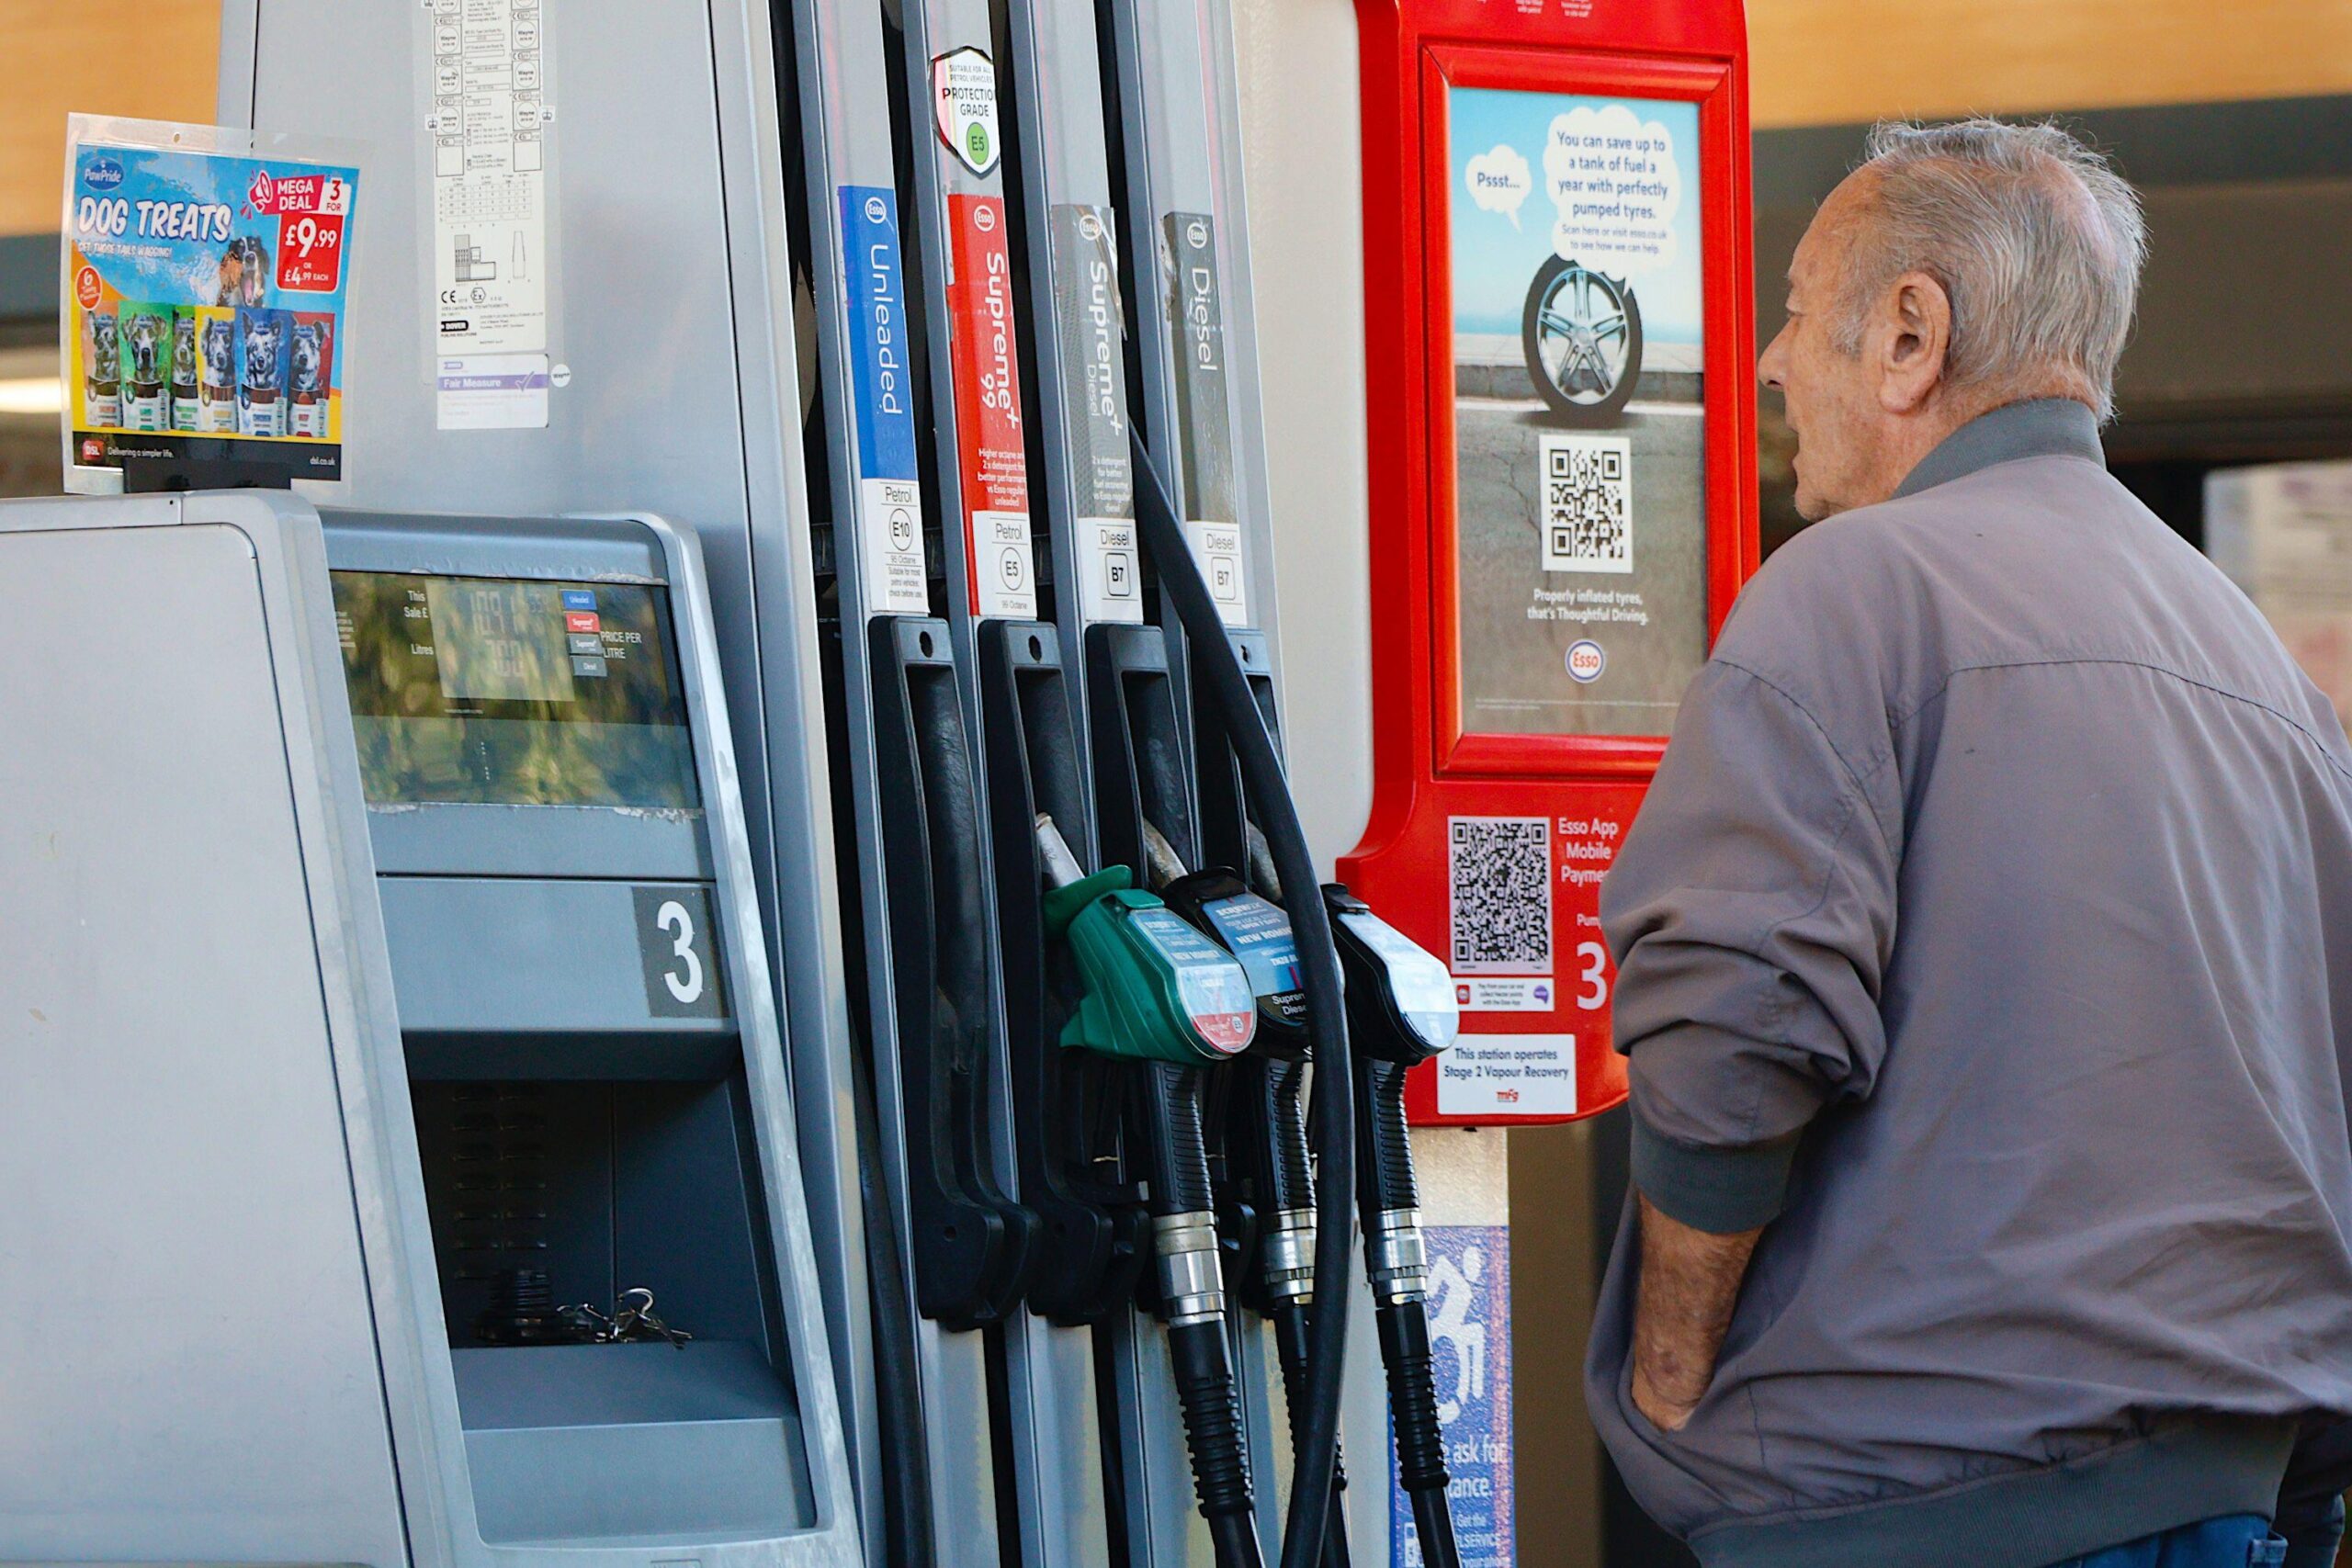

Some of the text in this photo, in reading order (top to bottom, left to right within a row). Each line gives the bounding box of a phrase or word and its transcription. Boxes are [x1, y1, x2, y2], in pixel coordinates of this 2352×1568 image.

[949, 64, 972, 73] SUITABLE
[950, 74, 993, 85] PETROL VEHICLES
[942, 87, 994, 101] PROTECTIO
[960, 104, 989, 117] GRADE
[971, 136, 985, 152] E5
[1557, 131, 1666, 154] You can save up to
[1568, 155, 1657, 174] a tank of fuel a
[84, 168, 121, 184] PawPride
[1477, 172, 1521, 189] Pssst...
[277, 179, 314, 195] MEGA
[329, 179, 342, 201] 3
[1558, 177, 1668, 201] year with perfectly
[278, 195, 312, 210] DEAL
[326, 202, 342, 211] FOR
[867, 203, 884, 216] Esso
[977, 212, 992, 224] Esso
[1573, 202, 1657, 222] pumped tyres.
[79, 197, 232, 243] DOG TREATS
[285, 218, 337, 258] £9.99
[1189, 228, 1205, 242] Esso
[1561, 223, 1668, 241] Scan here or visit esso.co.uk
[117, 245, 136, 256] TAILS
[1570, 240, 1578, 250] to
[1580, 243, 1594, 251] see
[1596, 241, 1612, 253] how
[1615, 244, 1625, 253] we
[1628, 244, 1642, 254] can
[84, 270, 93, 287] 6
[1192, 268, 1218, 371] Diesel
[870, 244, 903, 414] Unleaded
[985, 252, 1019, 429] Supreme+
[1089, 261, 1123, 436] Supreme+
[443, 378, 502, 389] Fair Measure
[980, 373, 996, 409] 99
[1086, 365, 1101, 417] Diesel
[85, 446, 175, 458] DSL Delivering simpler life.
[978, 447, 998, 459] Higher
[310, 456, 336, 466] dsl.co.uk
[992, 461, 1017, 476] detergent
[977, 471, 997, 481] better
[1106, 468, 1122, 478] better
[885, 486, 912, 503] Petrol
[994, 484, 1007, 494] Esso
[994, 496, 1019, 506] unleaded
[892, 521, 910, 537] E10
[996, 524, 1023, 540] Petrol
[1101, 529, 1130, 546] Diesel
[1206, 534, 1235, 549] Diesel
[899, 556, 916, 565] Octane
[1005, 561, 1019, 577] E5
[1112, 567, 1124, 582] B7
[1217, 571, 1229, 585] B7
[407, 591, 426, 602] This
[1533, 588, 1644, 607] Properly inflated tyres,
[404, 606, 429, 618] Sale £
[1010, 601, 1027, 611] Octane
[1527, 606, 1649, 626] that's Thoughtful Driving.
[600, 631, 642, 643] PRICE PER
[411, 643, 434, 656] Litres
[604, 648, 627, 660] LITRE
[1572, 651, 1600, 669] Esso
[1558, 817, 1619, 840] Esso App
[1566, 841, 1612, 860] Mobile
[1236, 932, 1262, 945] NEW
[657, 900, 704, 1004] 3
[1577, 942, 1608, 1010] 3
[1455, 1048, 1558, 1063] This station operates
[1444, 1065, 1569, 1081] Stage 2 Vapour Recovery
[1497, 1089, 1520, 1102] mfg
[1453, 1434, 1479, 1464] ask
[1483, 1434, 1509, 1463] for
